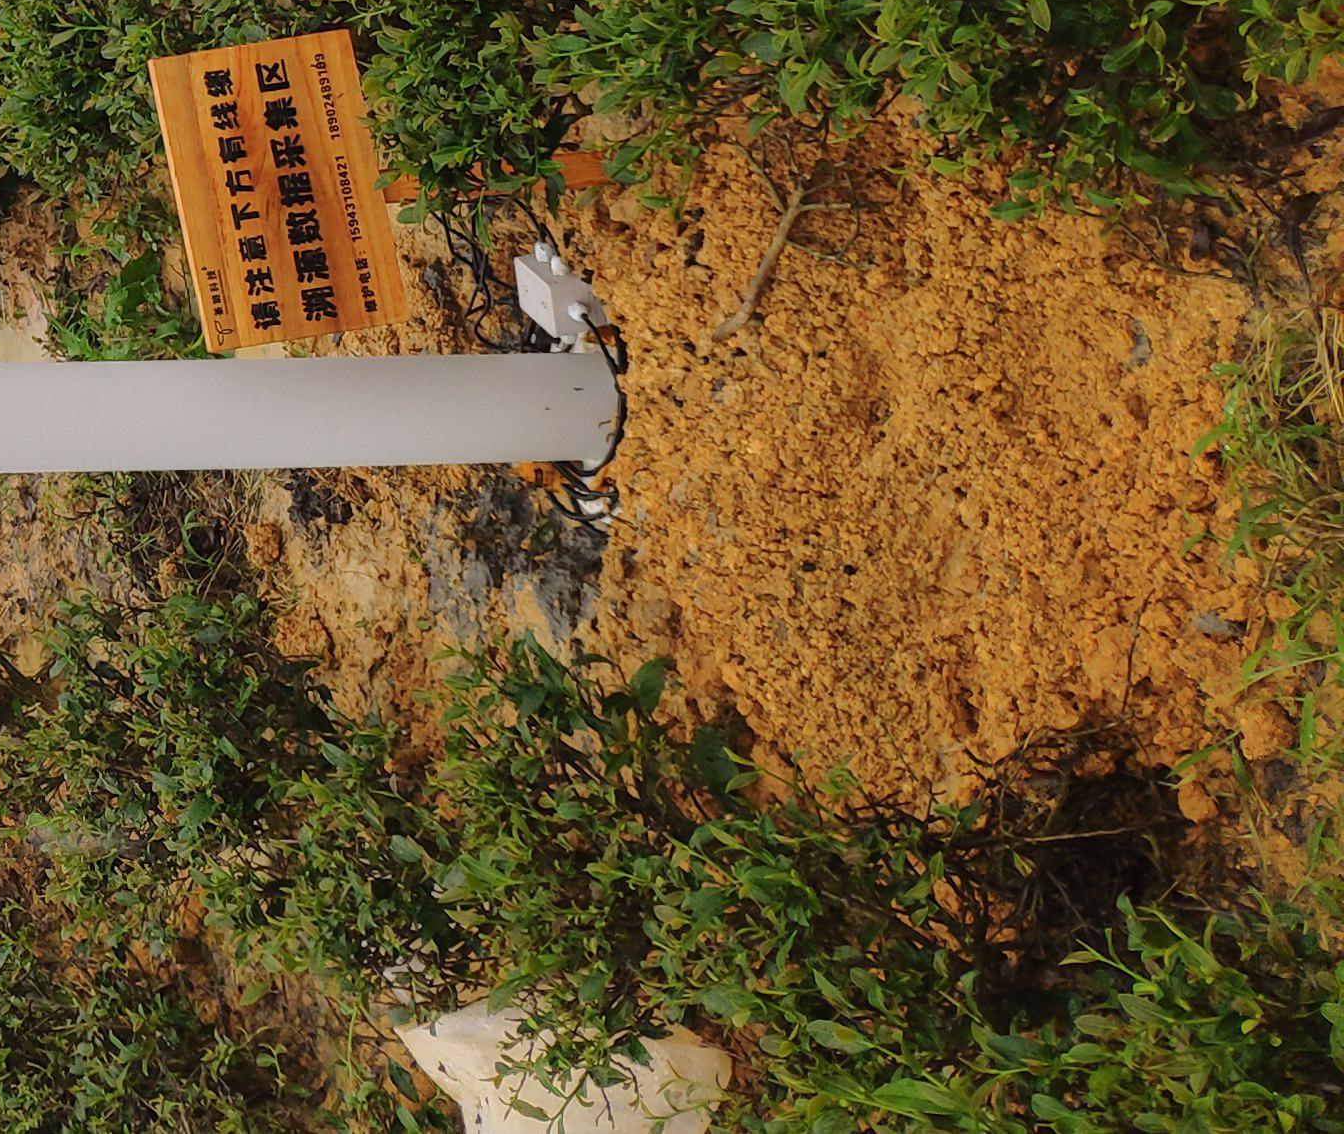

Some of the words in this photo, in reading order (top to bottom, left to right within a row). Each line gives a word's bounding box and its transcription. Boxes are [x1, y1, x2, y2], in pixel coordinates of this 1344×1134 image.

[203, 68, 282, 330] 请注意下方有线缆
[255, 59, 339, 322] 溯源数据采集区
